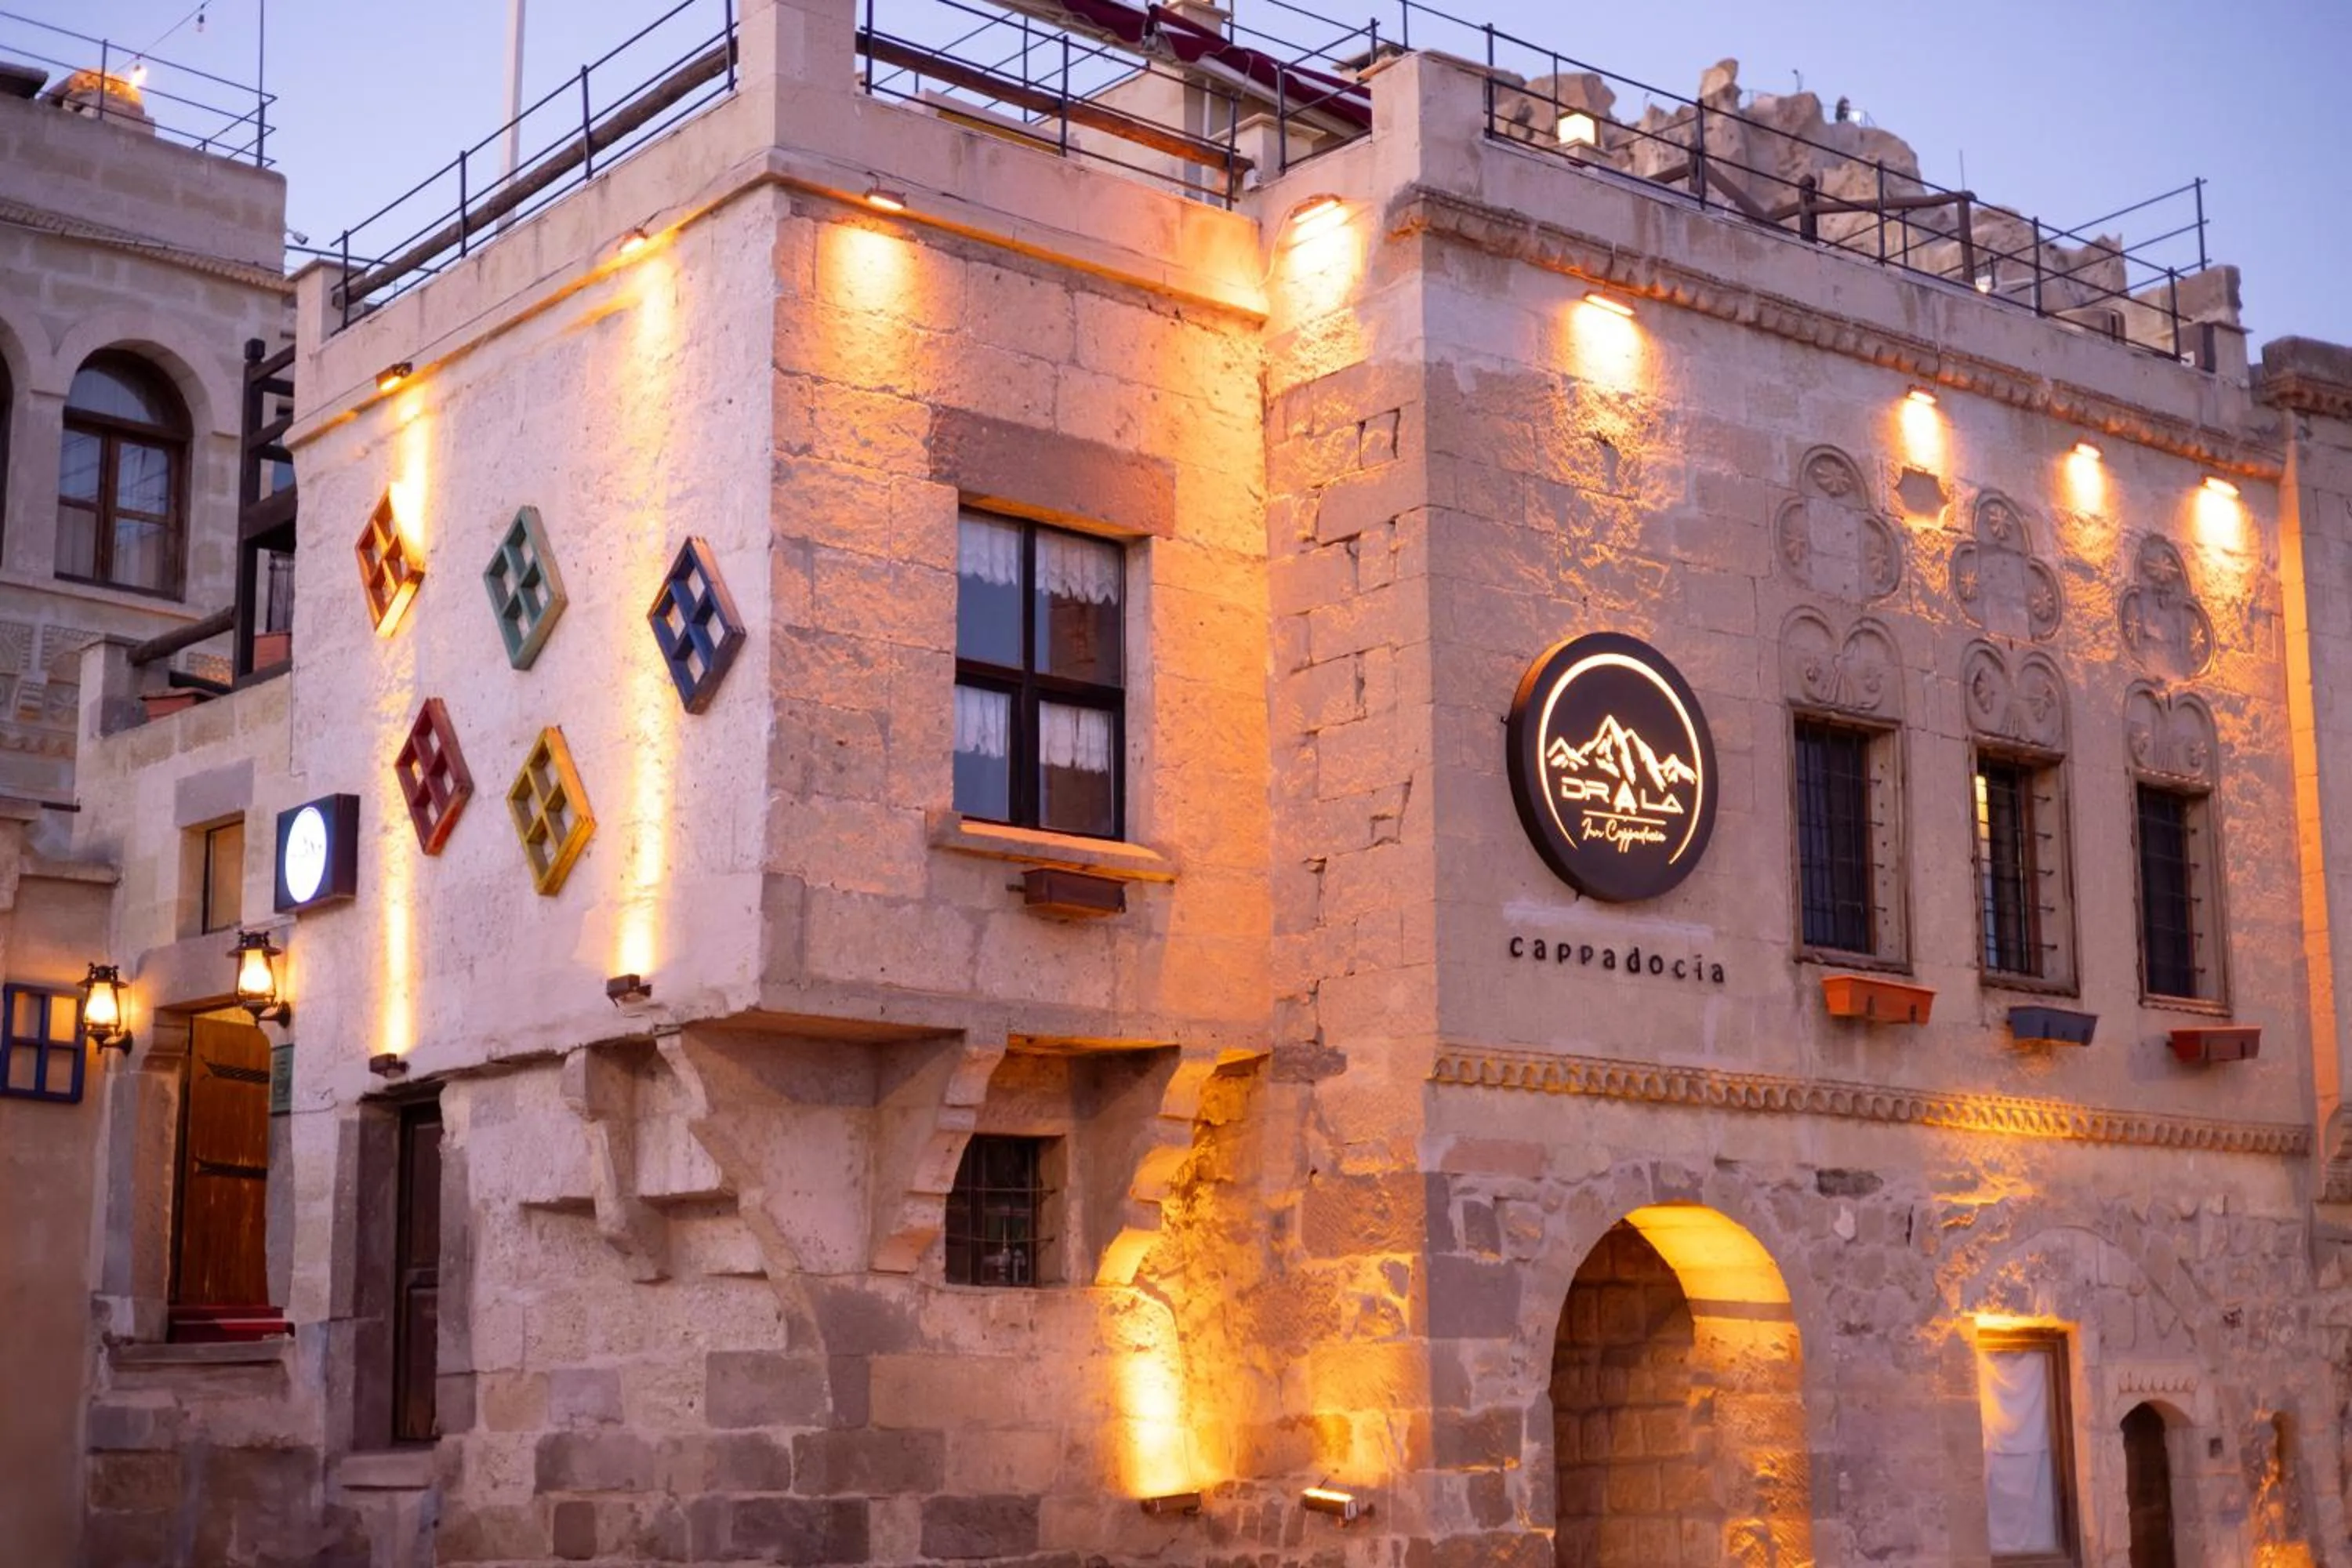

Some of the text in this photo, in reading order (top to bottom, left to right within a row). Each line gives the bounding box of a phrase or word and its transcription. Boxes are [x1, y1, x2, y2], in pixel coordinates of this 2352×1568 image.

[1561, 776, 1684, 815] DRALA
[1581, 818, 1604, 840] Inn
[1509, 936, 1724, 983] cappadocia
